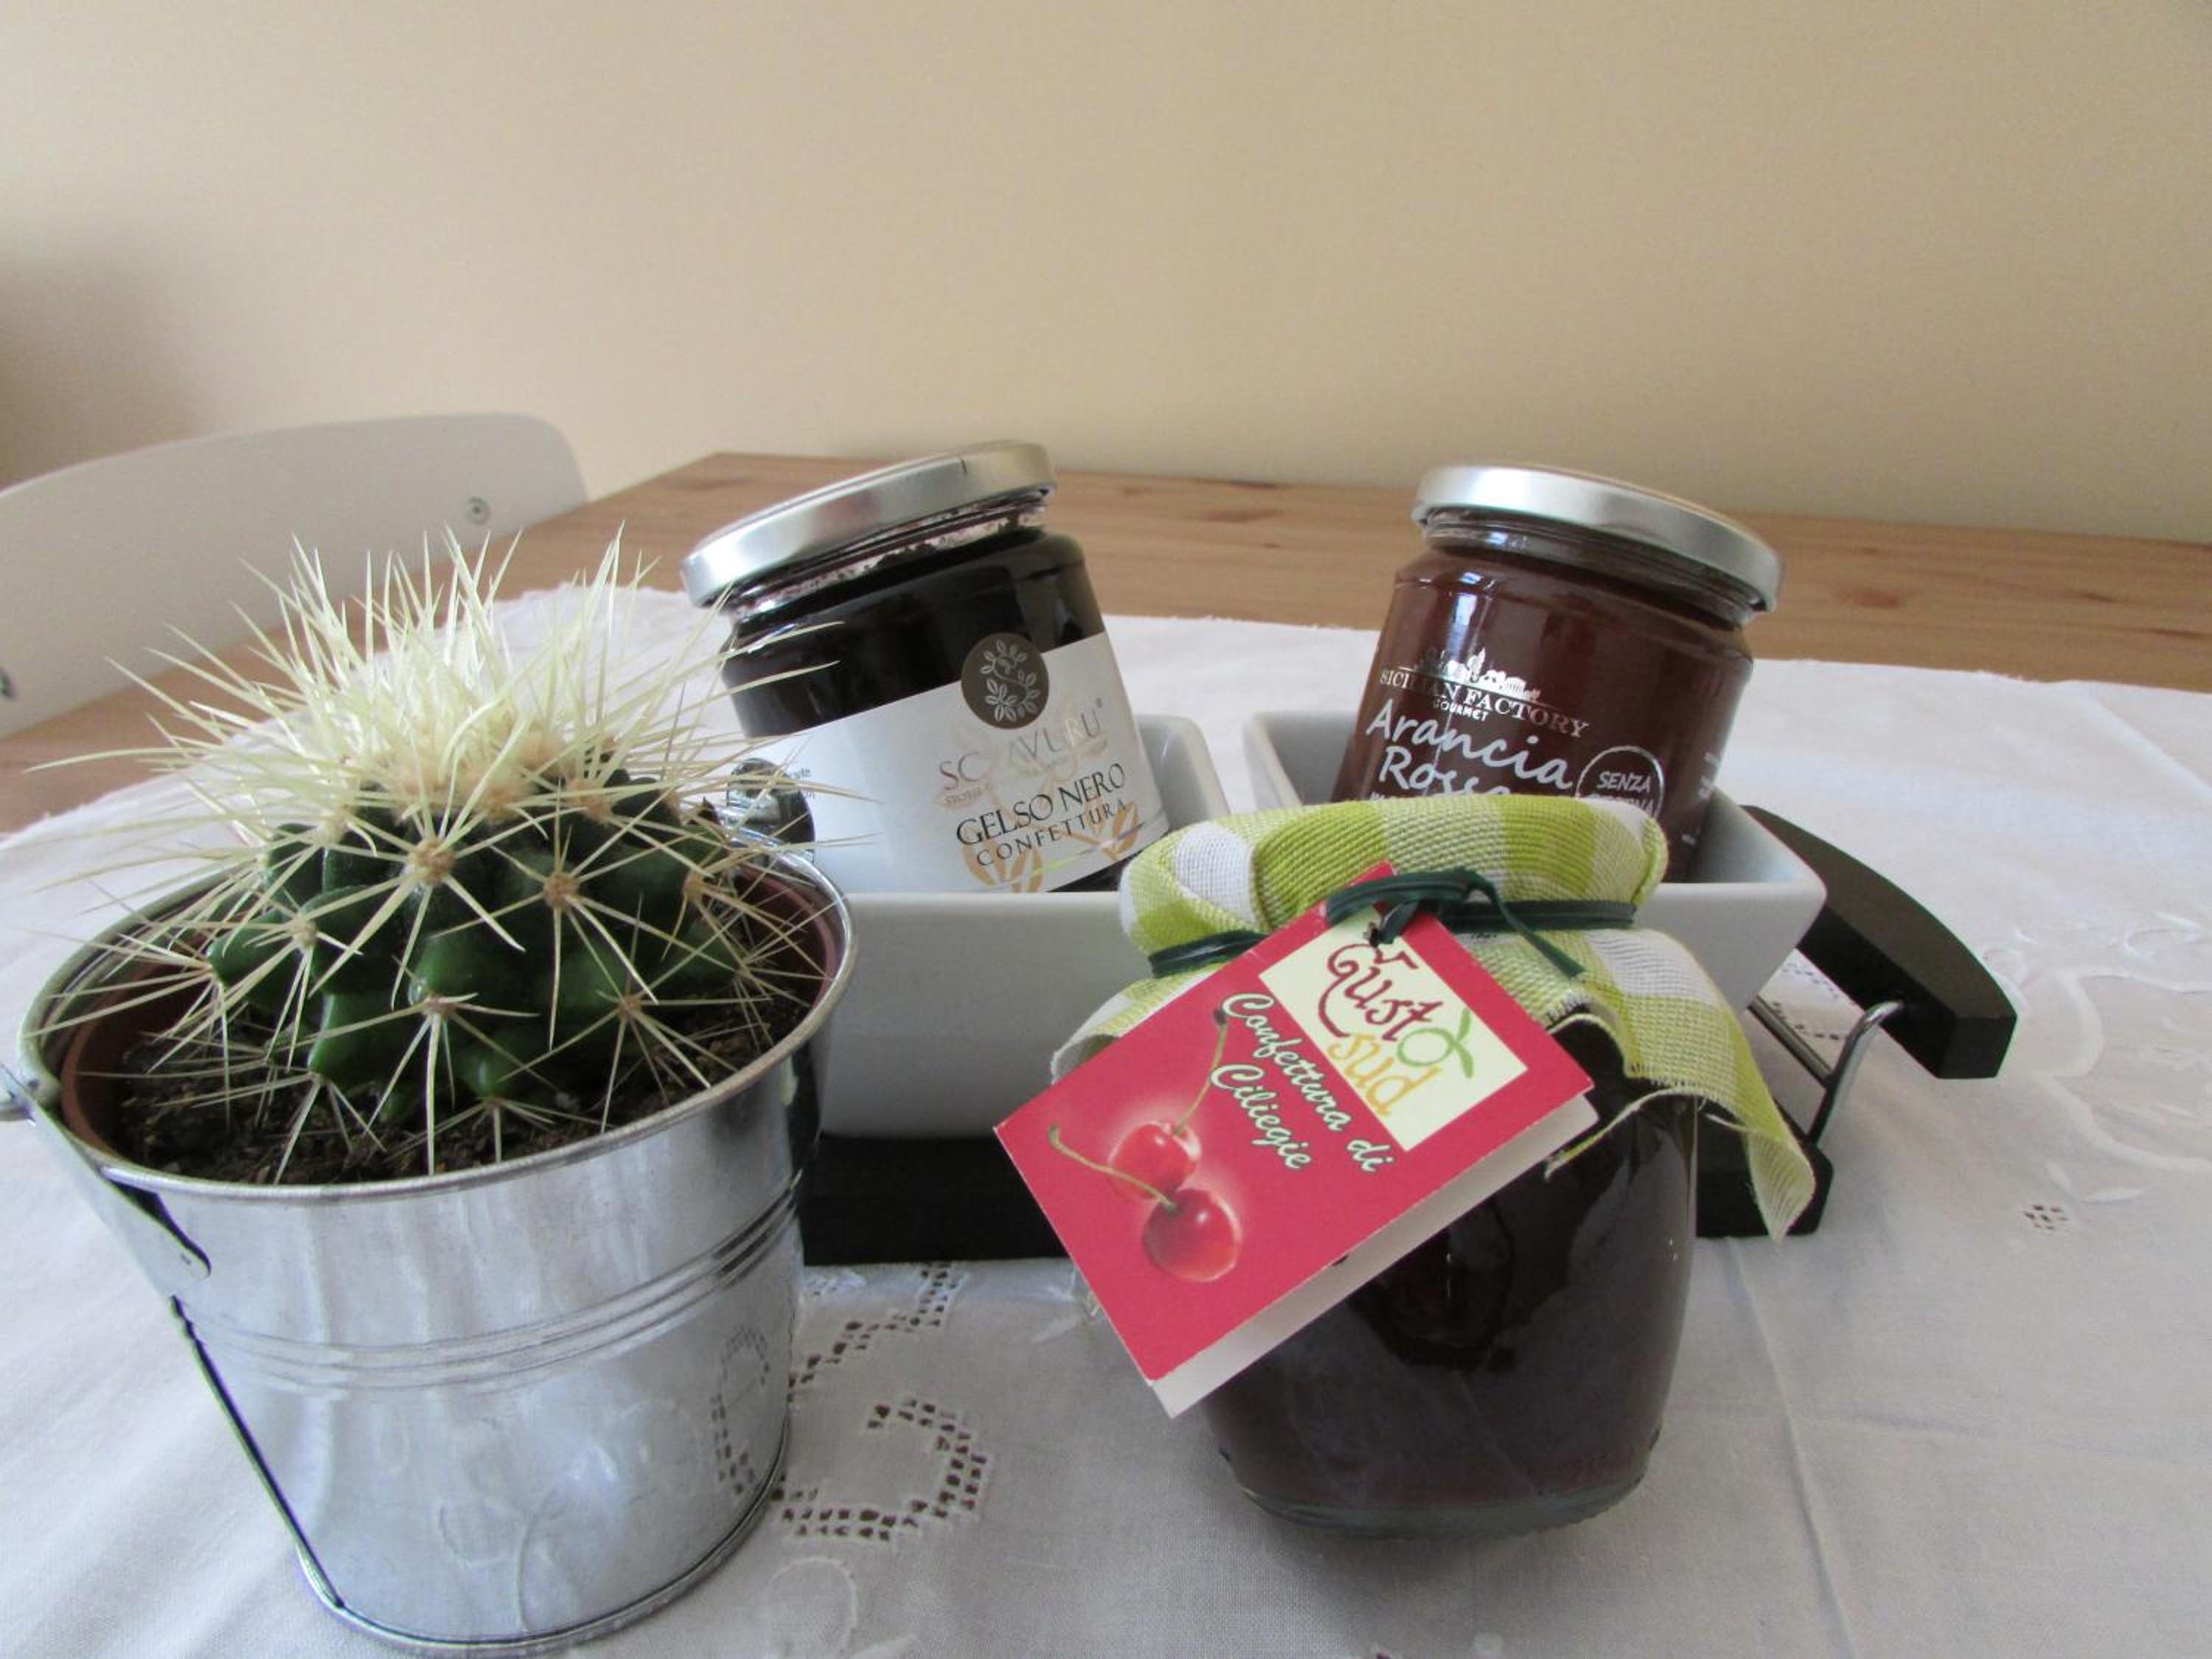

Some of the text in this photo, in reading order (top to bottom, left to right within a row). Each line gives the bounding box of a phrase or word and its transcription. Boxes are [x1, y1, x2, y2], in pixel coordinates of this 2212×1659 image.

[1366, 698, 1573, 790] Arancia
[1463, 689, 1590, 738] FACTORY
[956, 762, 1125, 846] GELSO NERO
[1378, 745, 1511, 796] Ross
[1596, 771, 1652, 793] SENZA
[977, 799, 1127, 866] CONFETTURA
[1210, 1063, 1311, 1169] Ciliegie
[1221, 992, 1394, 1172] Confettura di
[1328, 1033, 1441, 1116] sud
